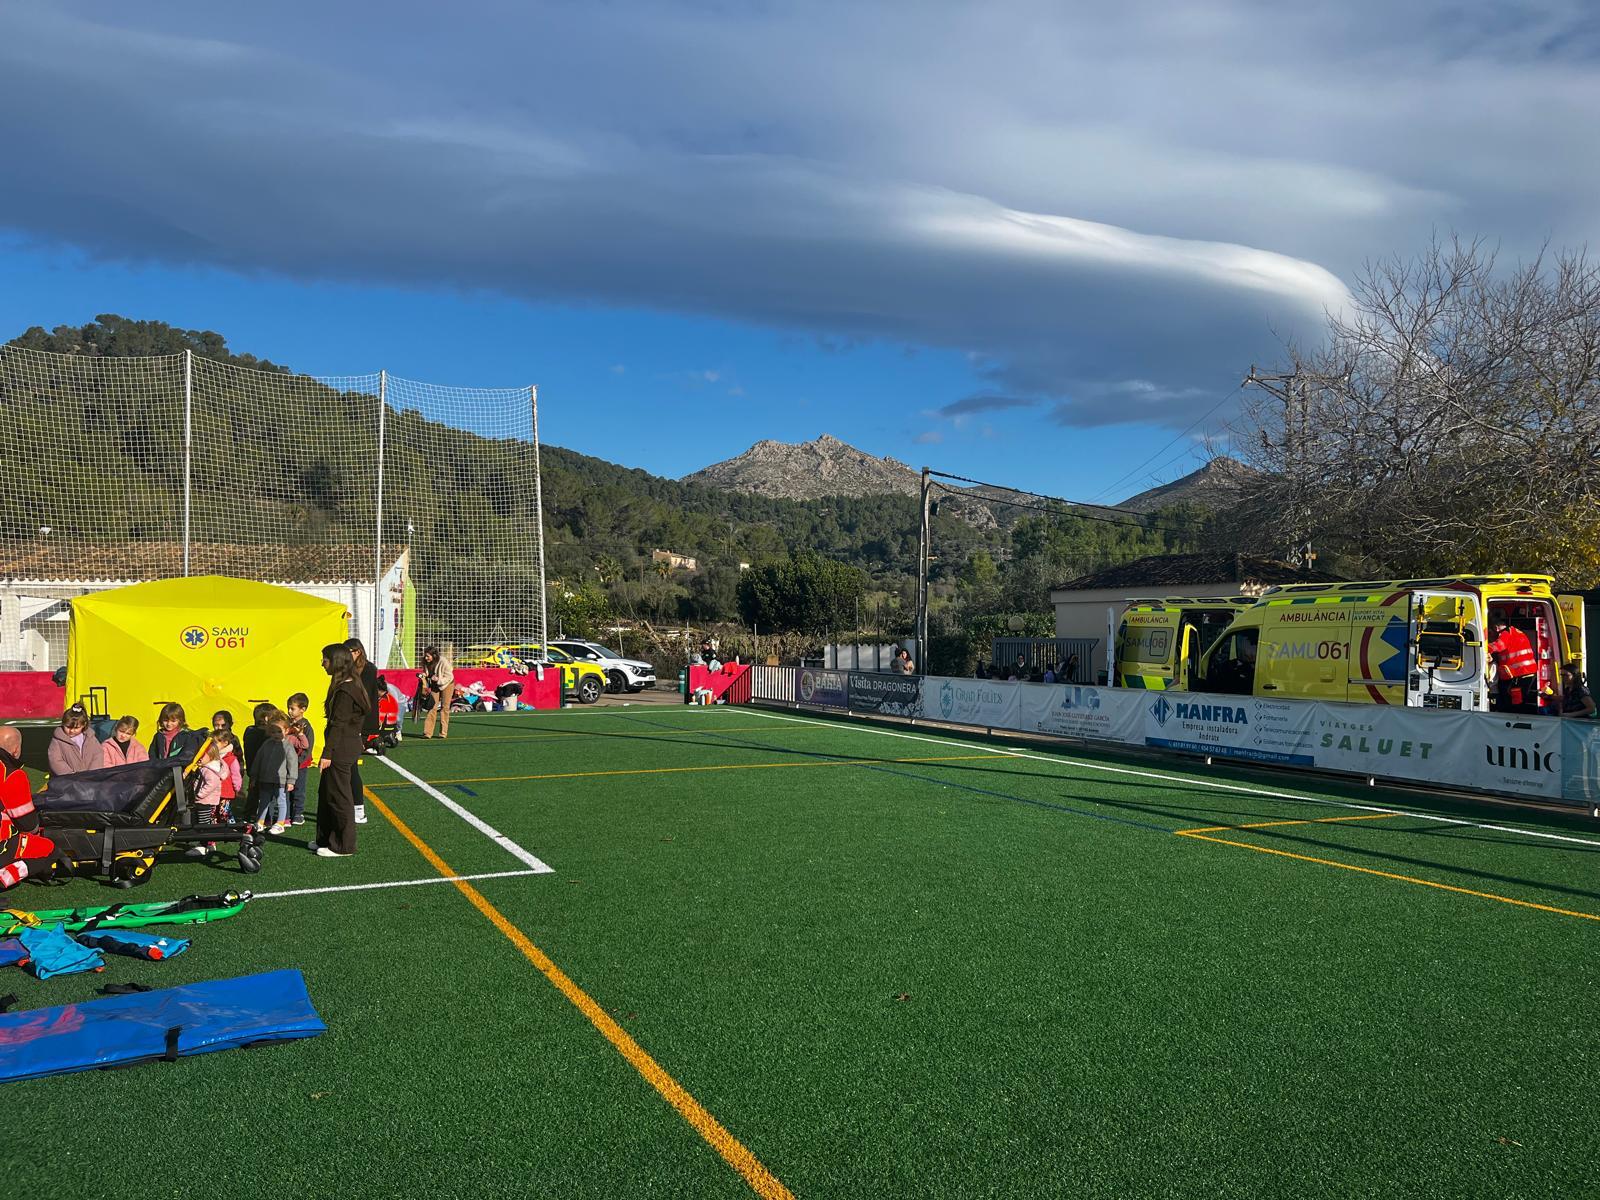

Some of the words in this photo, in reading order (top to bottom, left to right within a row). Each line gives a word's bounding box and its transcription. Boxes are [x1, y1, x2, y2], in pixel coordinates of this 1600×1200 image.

[212, 627, 249, 636] SAMU
[215, 637, 245, 649] 061
[850, 675, 872, 690] Visita
[873, 681, 917, 694] DRAGONERA
[1176, 703, 1249, 725] MANFRA
[1182, 721, 1204, 732] Empresa
[1320, 720, 1374, 732] VIATGES
[1320, 733, 1433, 759] SALUET
